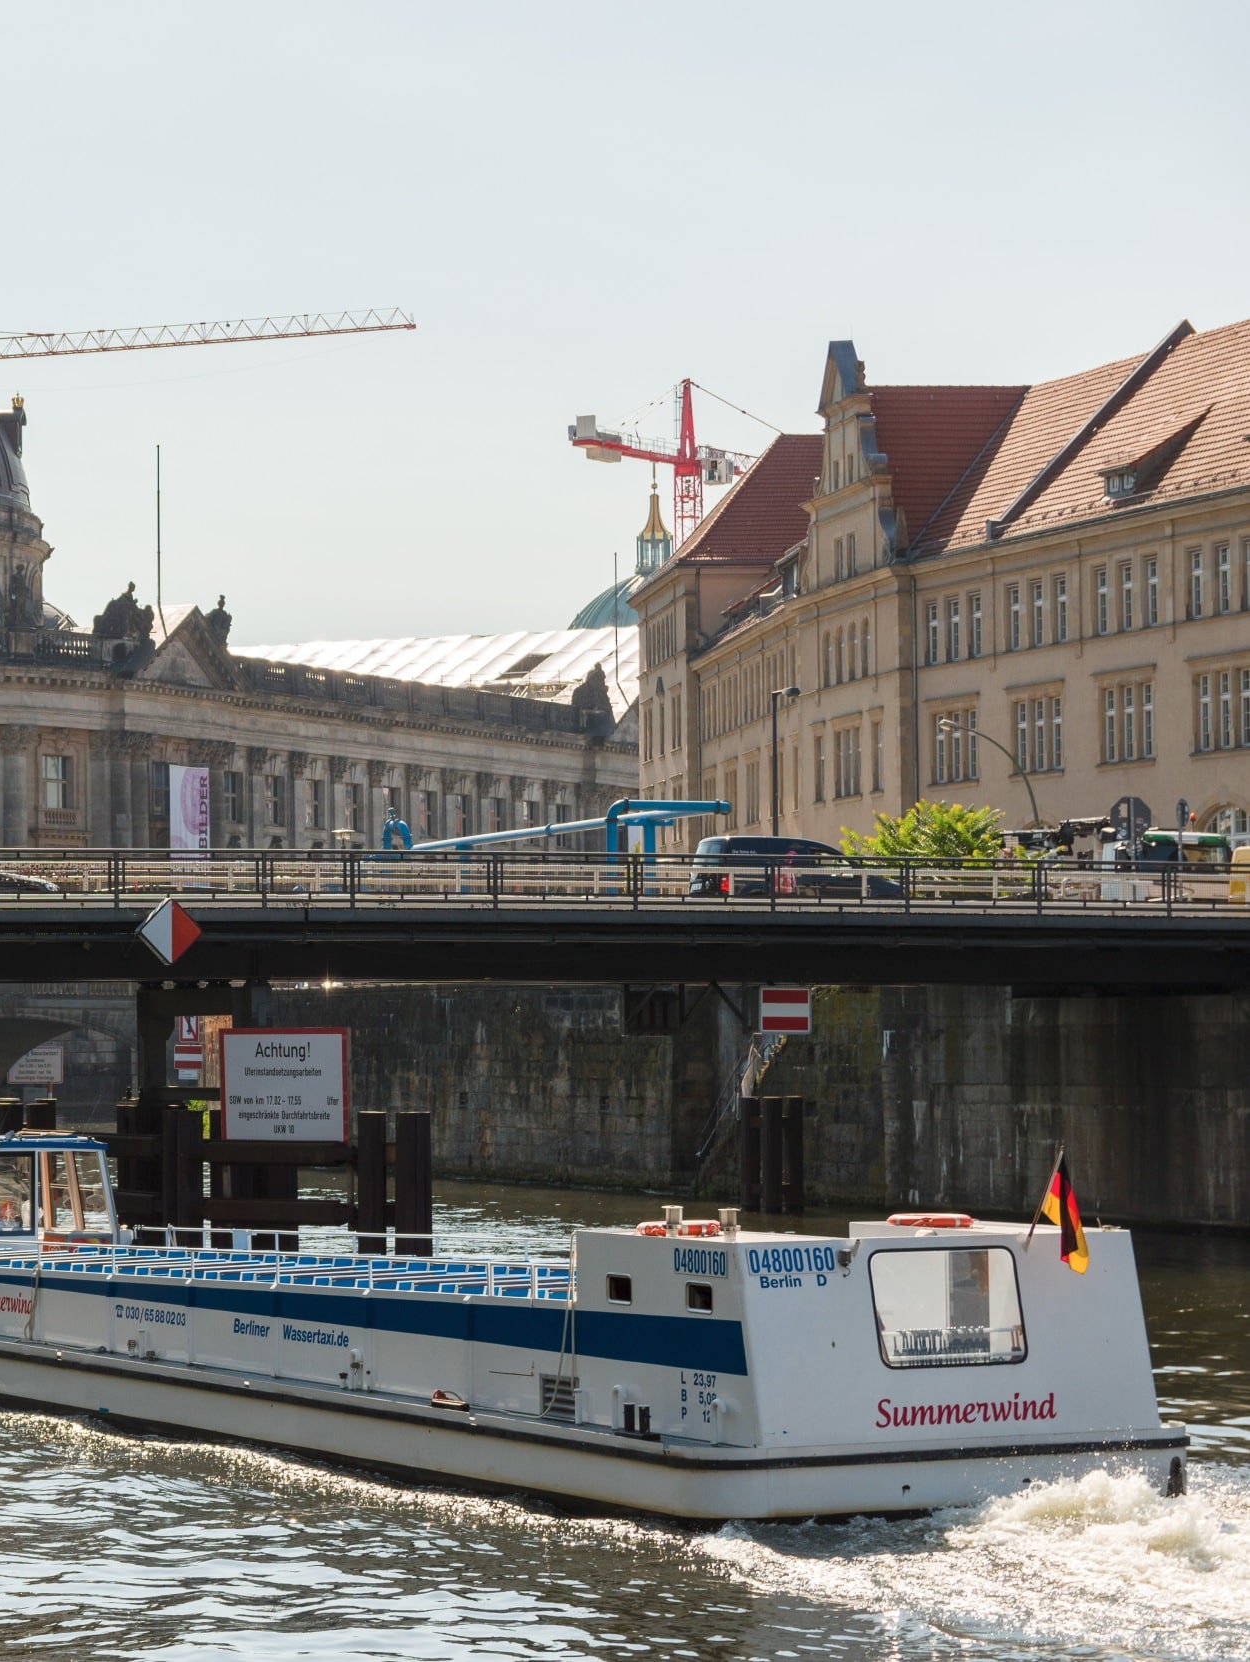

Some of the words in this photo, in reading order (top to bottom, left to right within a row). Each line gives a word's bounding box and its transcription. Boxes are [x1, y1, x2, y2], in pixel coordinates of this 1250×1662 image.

[255, 1042, 311, 1062] Achtung!
[243, 1097, 254, 1105] von
[255, 1095, 265, 1105] km
[327, 1096, 339, 1105] Ufer
[238, 1109, 280, 1121] eingeschränkte
[281, 1110, 330, 1120] Durchfahrtsbreite
[273, 1125, 286, 1134] UKW
[288, 1125, 295, 1134] 10
[673, 1247, 726, 1276] 04800160
[749, 1246, 836, 1274] 04800160
[760, 1274, 802, 1288] Berlin
[817, 1274, 827, 1287] D
[233, 1317, 271, 1338] Berliner
[282, 1323, 349, 1348] Wassertaxi.de
[681, 1371, 686, 1384] L
[693, 1373, 716, 1389] 23,97
[681, 1388, 688, 1402] B
[681, 1406, 687, 1420] P
[875, 1392, 1057, 1428] Summerwind
